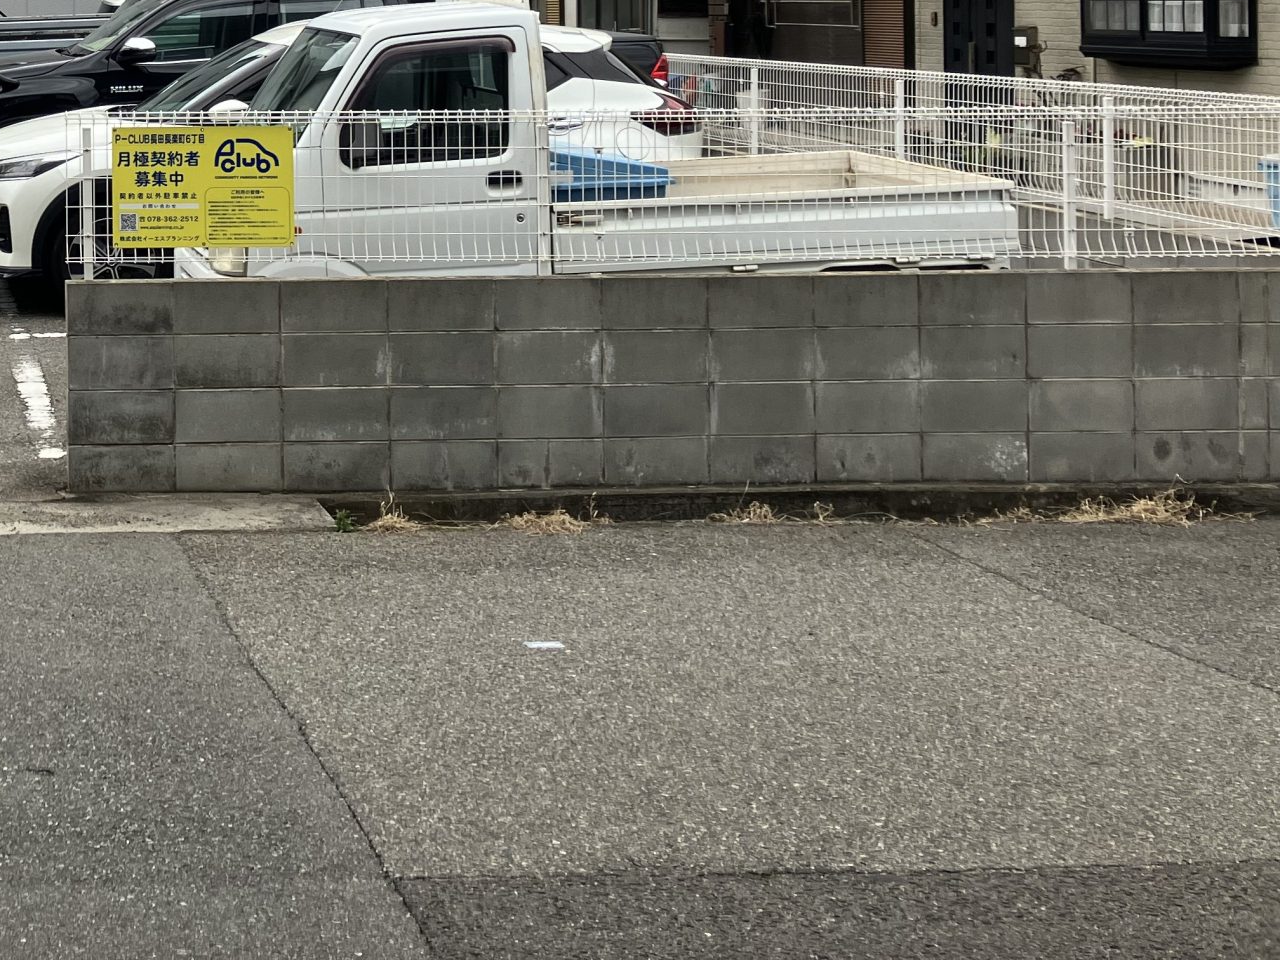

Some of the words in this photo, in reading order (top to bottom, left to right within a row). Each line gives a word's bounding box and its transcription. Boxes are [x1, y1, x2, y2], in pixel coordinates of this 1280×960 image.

[109, 85, 144, 94] HILUX
[117, 151, 200, 167] 月極契約者
[134, 170, 184, 187] 募集中
[146, 215, 199, 223] 078-362-2512
